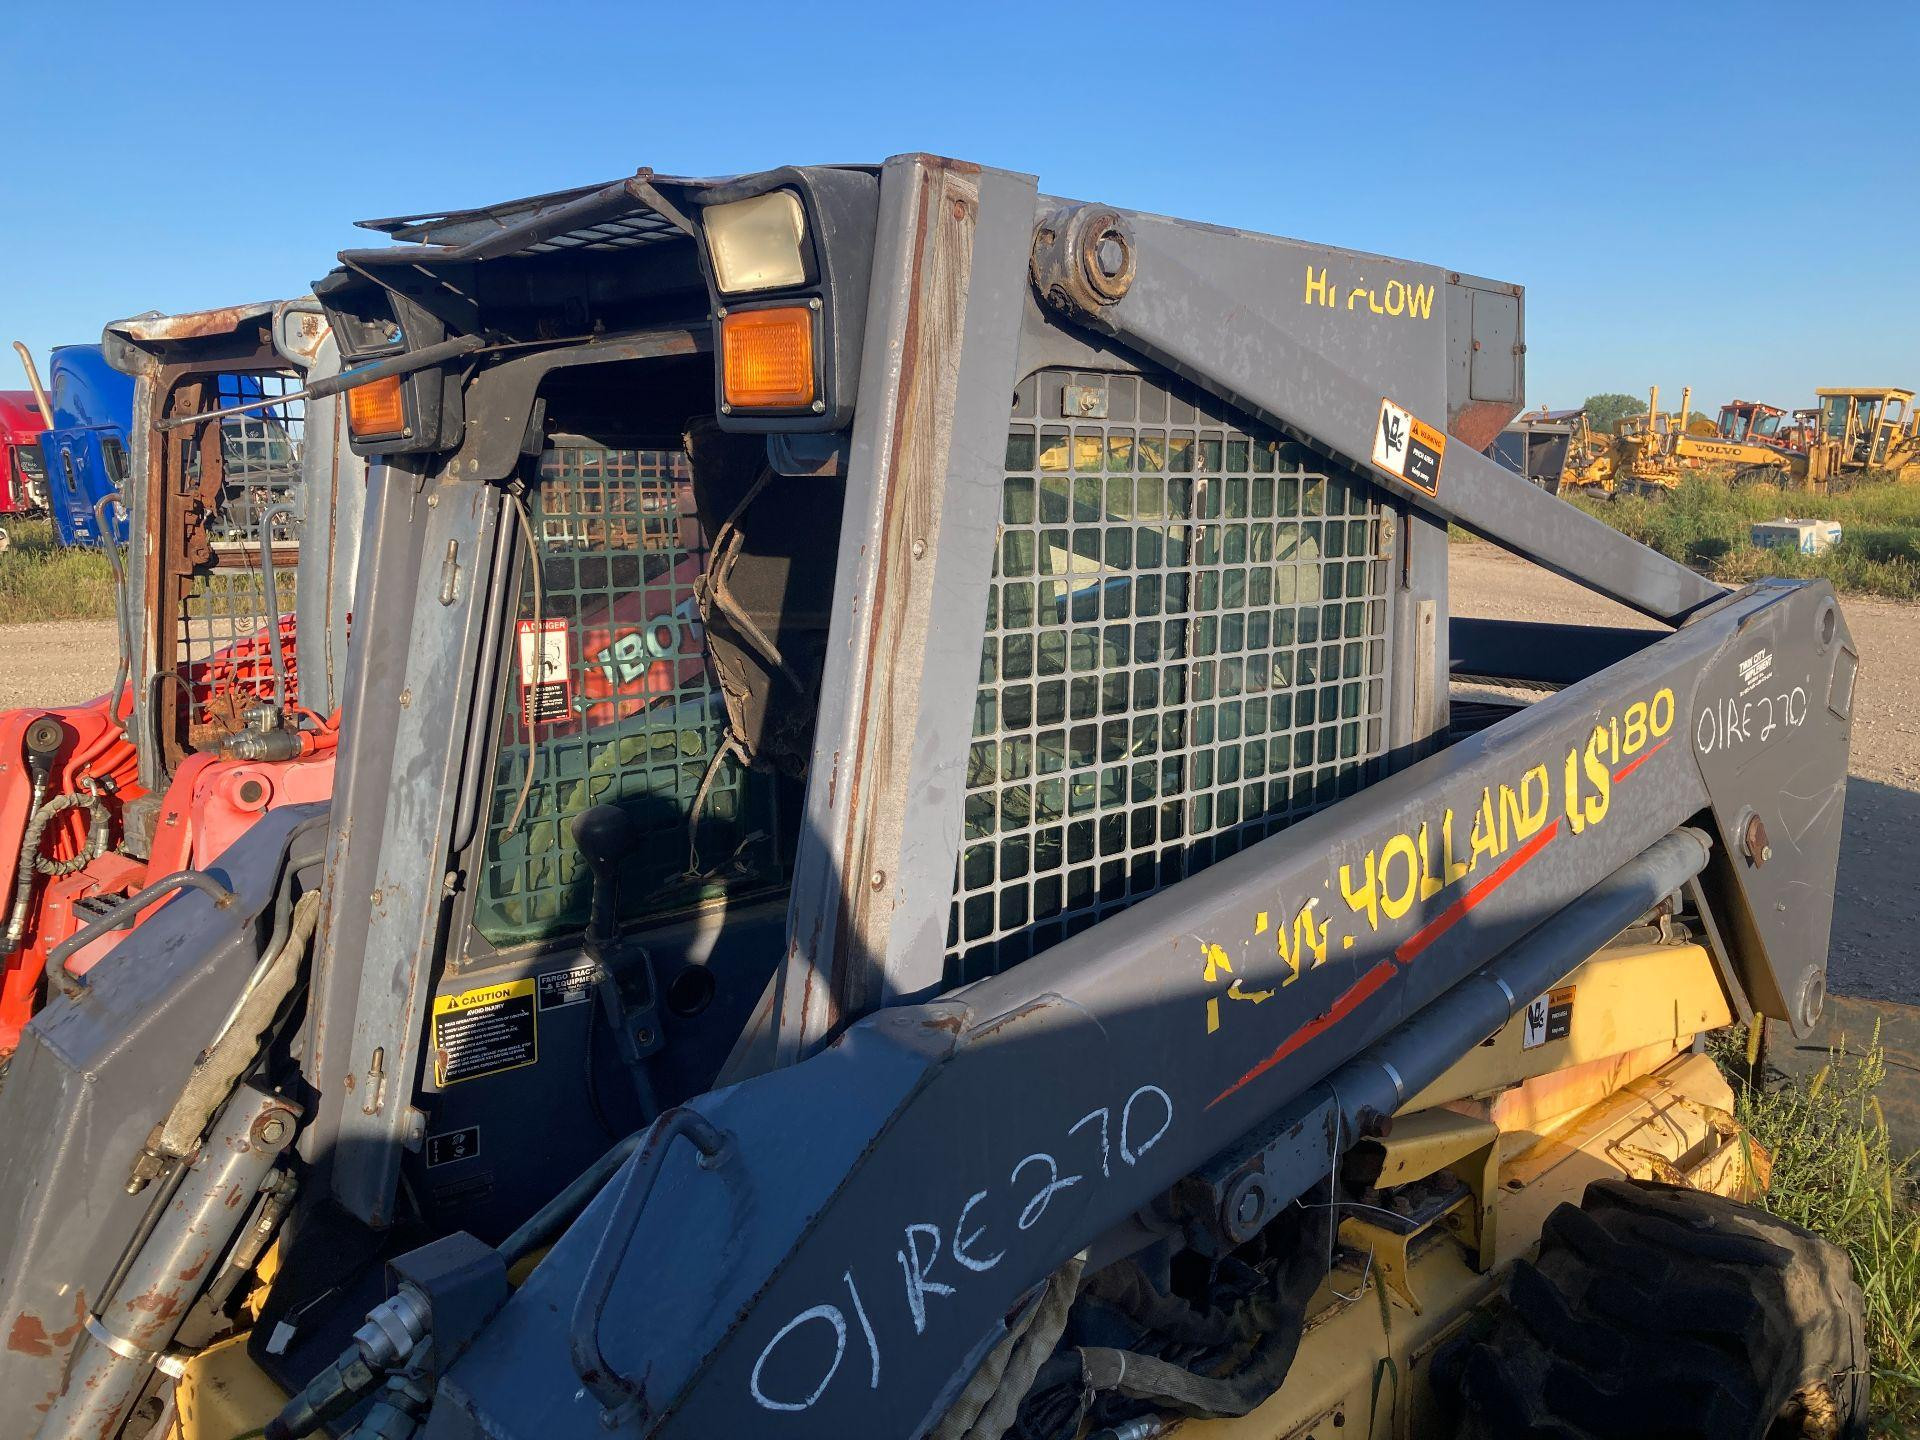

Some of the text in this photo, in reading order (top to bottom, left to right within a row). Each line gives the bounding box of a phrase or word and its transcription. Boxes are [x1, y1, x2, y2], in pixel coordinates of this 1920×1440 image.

[1695, 444, 1742, 456] VOLVO
[541, 973, 569, 984] FARGO
[555, 976, 594, 988] EQUIPME
[461, 988, 511, 1006] CAUTION
[466, 1006, 484, 1016] AVOID
